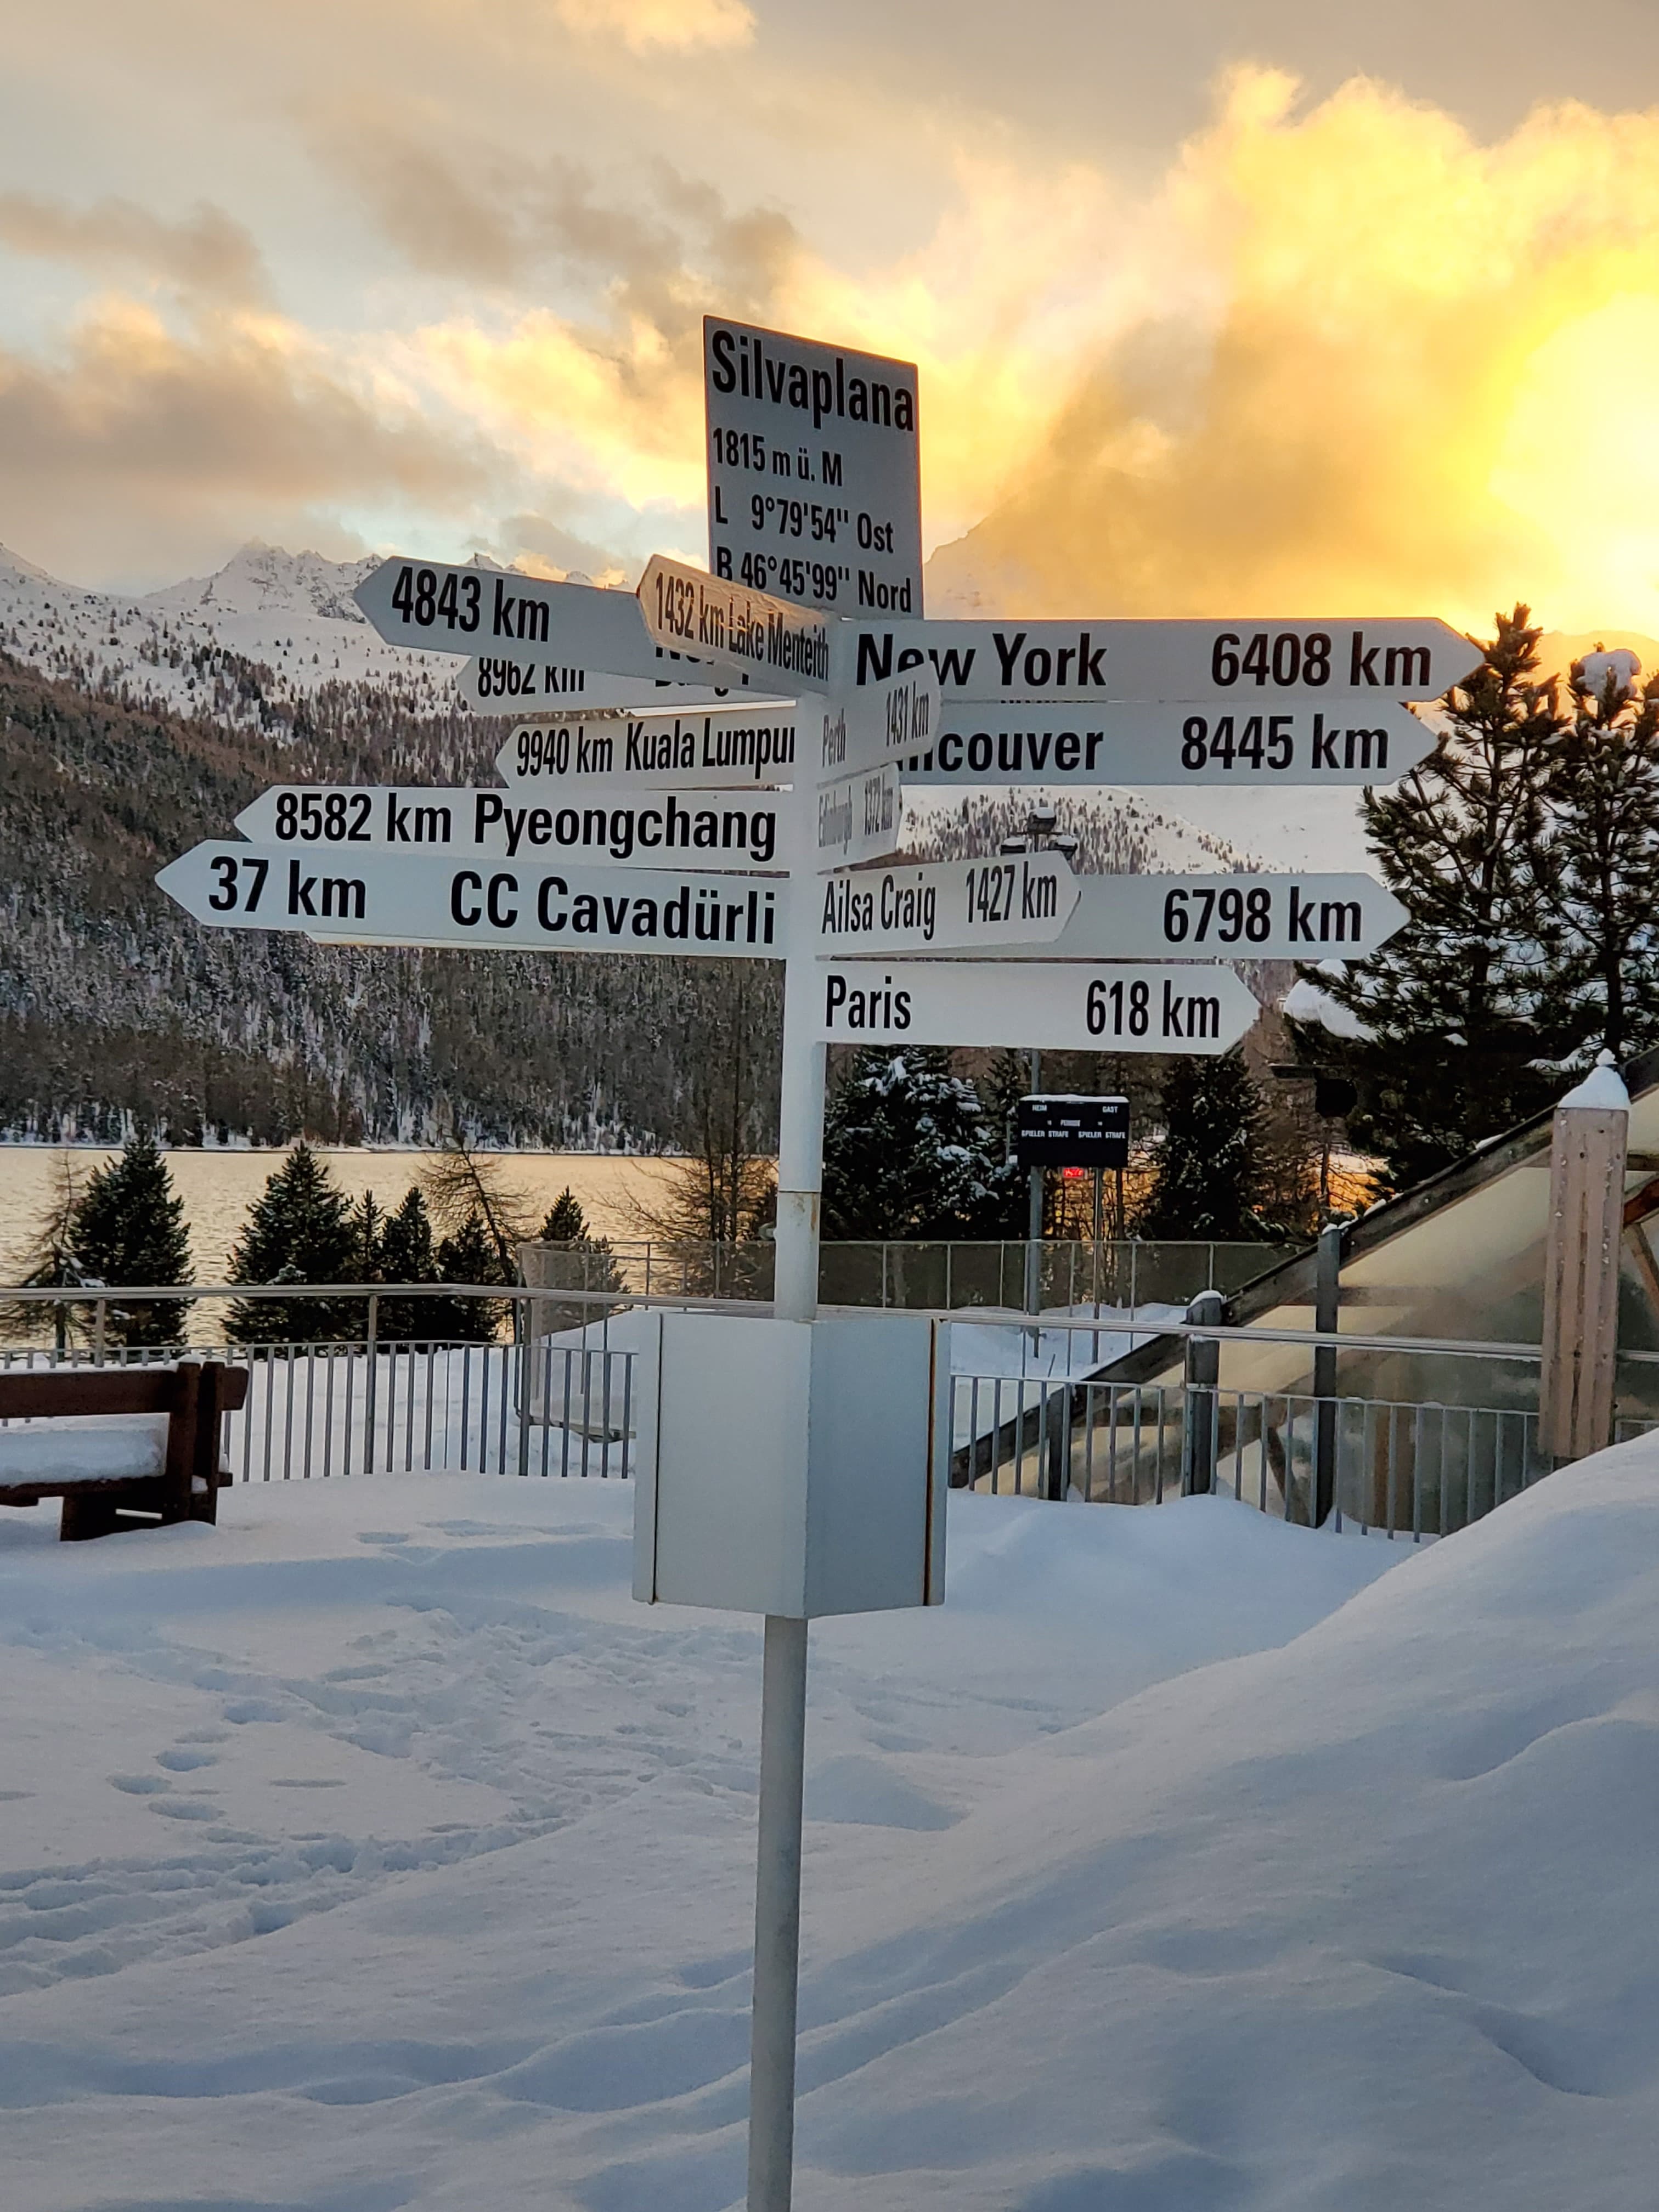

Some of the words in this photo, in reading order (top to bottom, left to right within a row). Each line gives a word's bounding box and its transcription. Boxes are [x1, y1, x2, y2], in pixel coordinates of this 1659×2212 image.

[712, 330, 913, 431] Silvaplana
[713, 427, 765, 471] 1815
[772, 450, 791, 476] m
[798, 448, 815, 481] ü.
[823, 451, 842, 487] M
[715, 486, 728, 524] L
[857, 513, 894, 554] Ost
[392, 566, 481, 632] 4843
[493, 579, 549, 642] km
[716, 546, 732, 581] B
[859, 570, 911, 613] Nord
[656, 572, 695, 639] 1432
[699, 585, 724, 648] km
[729, 598, 764, 660] Lake
[768, 613, 829, 681] Menteith
[856, 633, 976, 686] New
[992, 633, 1107, 686] York
[1211, 633, 1331, 686] 6408
[1350, 631, 1431, 686] km
[478, 657, 535, 697] 8962
[545, 665, 584, 693] km
[517, 729, 569, 777] 9940
[577, 726, 613, 773] km
[625, 719, 695, 771] Kuala
[822, 708, 845, 767] Perth
[885, 685, 909, 747] 1431
[912, 682, 929, 738] km
[1181, 715, 1294, 770] 8445
[1312, 714, 1389, 769] km
[275, 792, 371, 842] 8582
[387, 792, 452, 843] km
[475, 793, 776, 862] Pyeongchang
[209, 856, 269, 912] 37
[288, 860, 366, 919] km
[450, 870, 518, 929] CC
[538, 877, 775, 944] Cavadürli
[822, 880, 873, 934] Ailsa
[881, 872, 935, 940] Craig
[966, 865, 1015, 923] 1427
[1022, 861, 1057, 919] km
[1164, 888, 1271, 942] 6798
[1289, 886, 1361, 942] km
[826, 975, 911, 1029] Paris
[1086, 980, 1149, 1036] 618
[1163, 980, 1220, 1038] km
